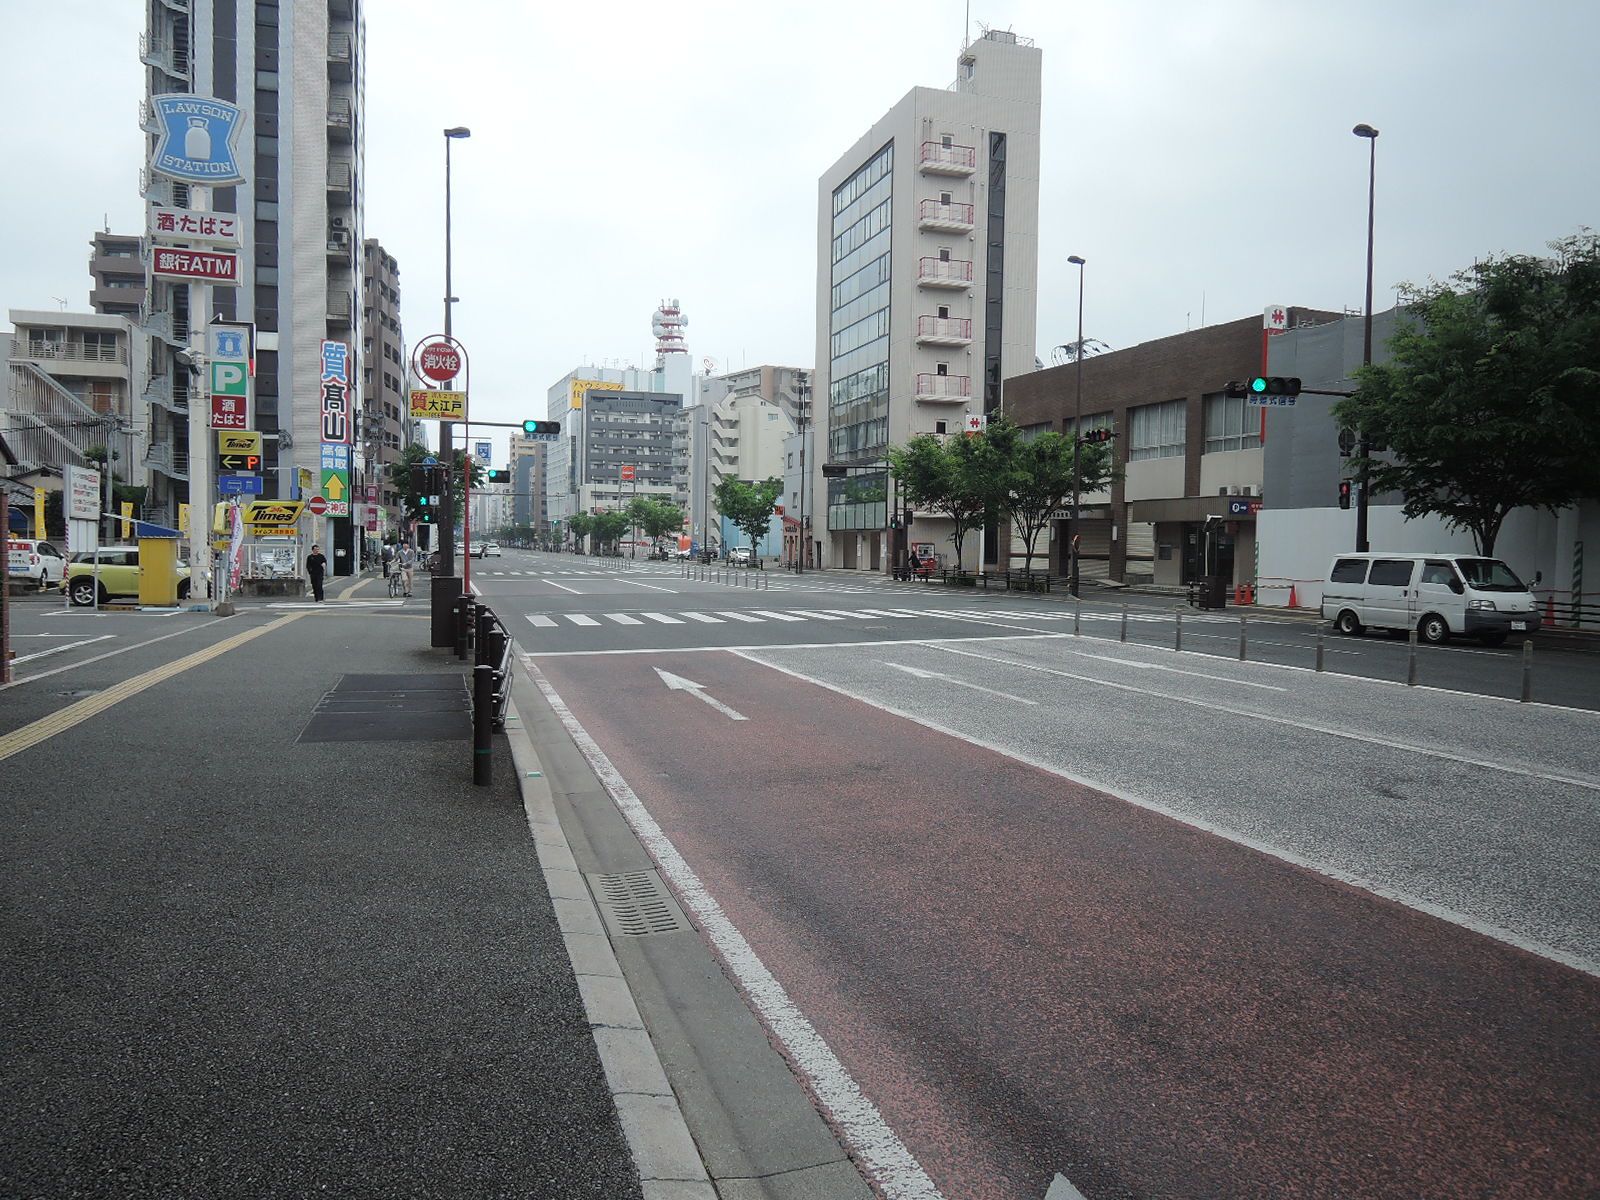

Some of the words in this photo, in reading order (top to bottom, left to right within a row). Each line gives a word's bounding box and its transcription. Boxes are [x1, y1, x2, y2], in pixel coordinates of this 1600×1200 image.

[163, 103, 233, 122] LAWSON
[162, 155, 232, 173] STATION
[159, 253, 232, 275] 銀行ATM
[424, 353, 458, 371] 消火栓
[215, 364, 243, 392] P
[221, 399, 236, 412] 酒
[411, 392, 428, 411] 質
[428, 399, 462, 413] 大江戸
[213, 413, 245, 426] たばこ
[226, 438, 256, 449] Times
[247, 456, 259, 469] P
[250, 506, 299, 521] Times
